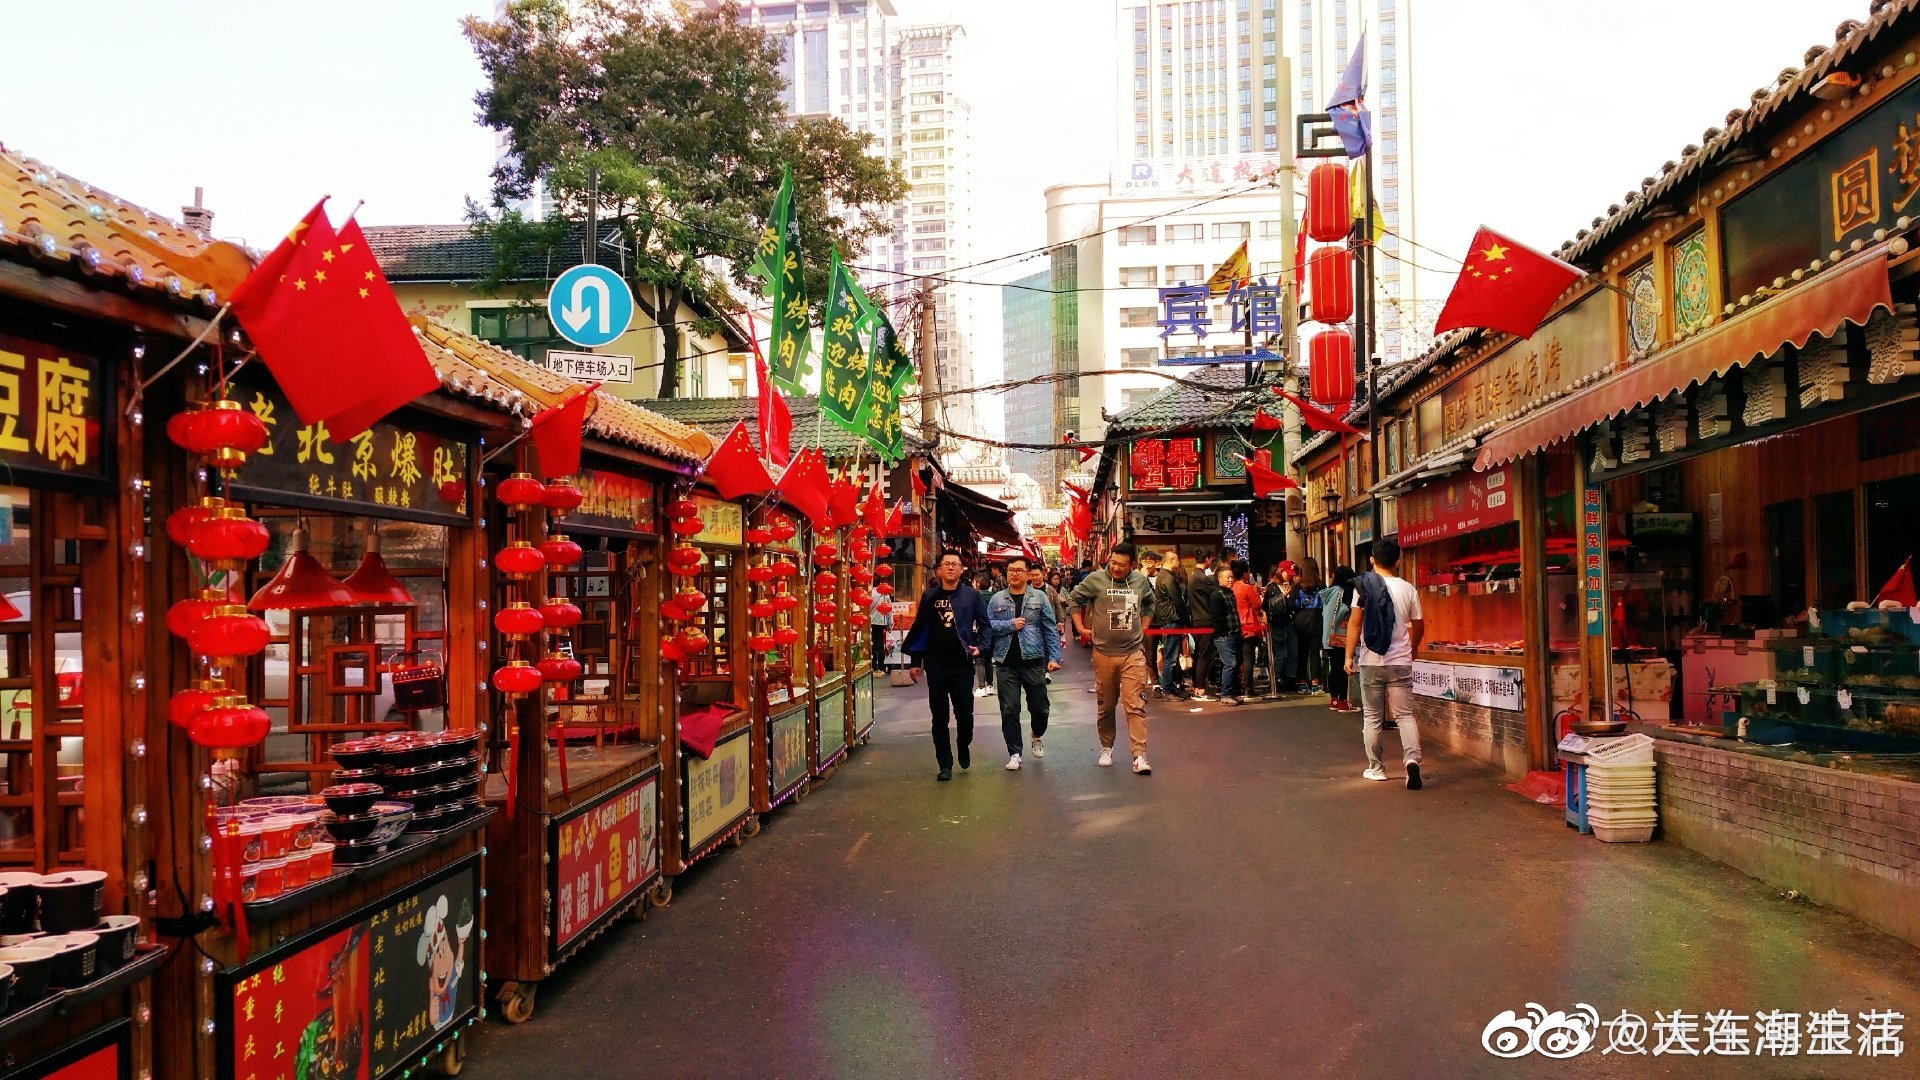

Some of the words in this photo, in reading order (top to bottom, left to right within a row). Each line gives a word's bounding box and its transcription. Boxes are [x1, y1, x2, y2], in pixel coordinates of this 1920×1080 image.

[1156, 277, 1281, 340] 宾馆
[552, 357, 628, 377] 地下停车场入口
[825, 314, 855, 398] 欢迎您
[838, 347, 867, 411] 烤肉
[0, 350, 90, 466] 豆腐
[249, 391, 457, 489] 老北京爆肚
[308, 472, 354, 500] 纯牛肚
[1584, 489, 1602, 612] 海鲜免费加工
